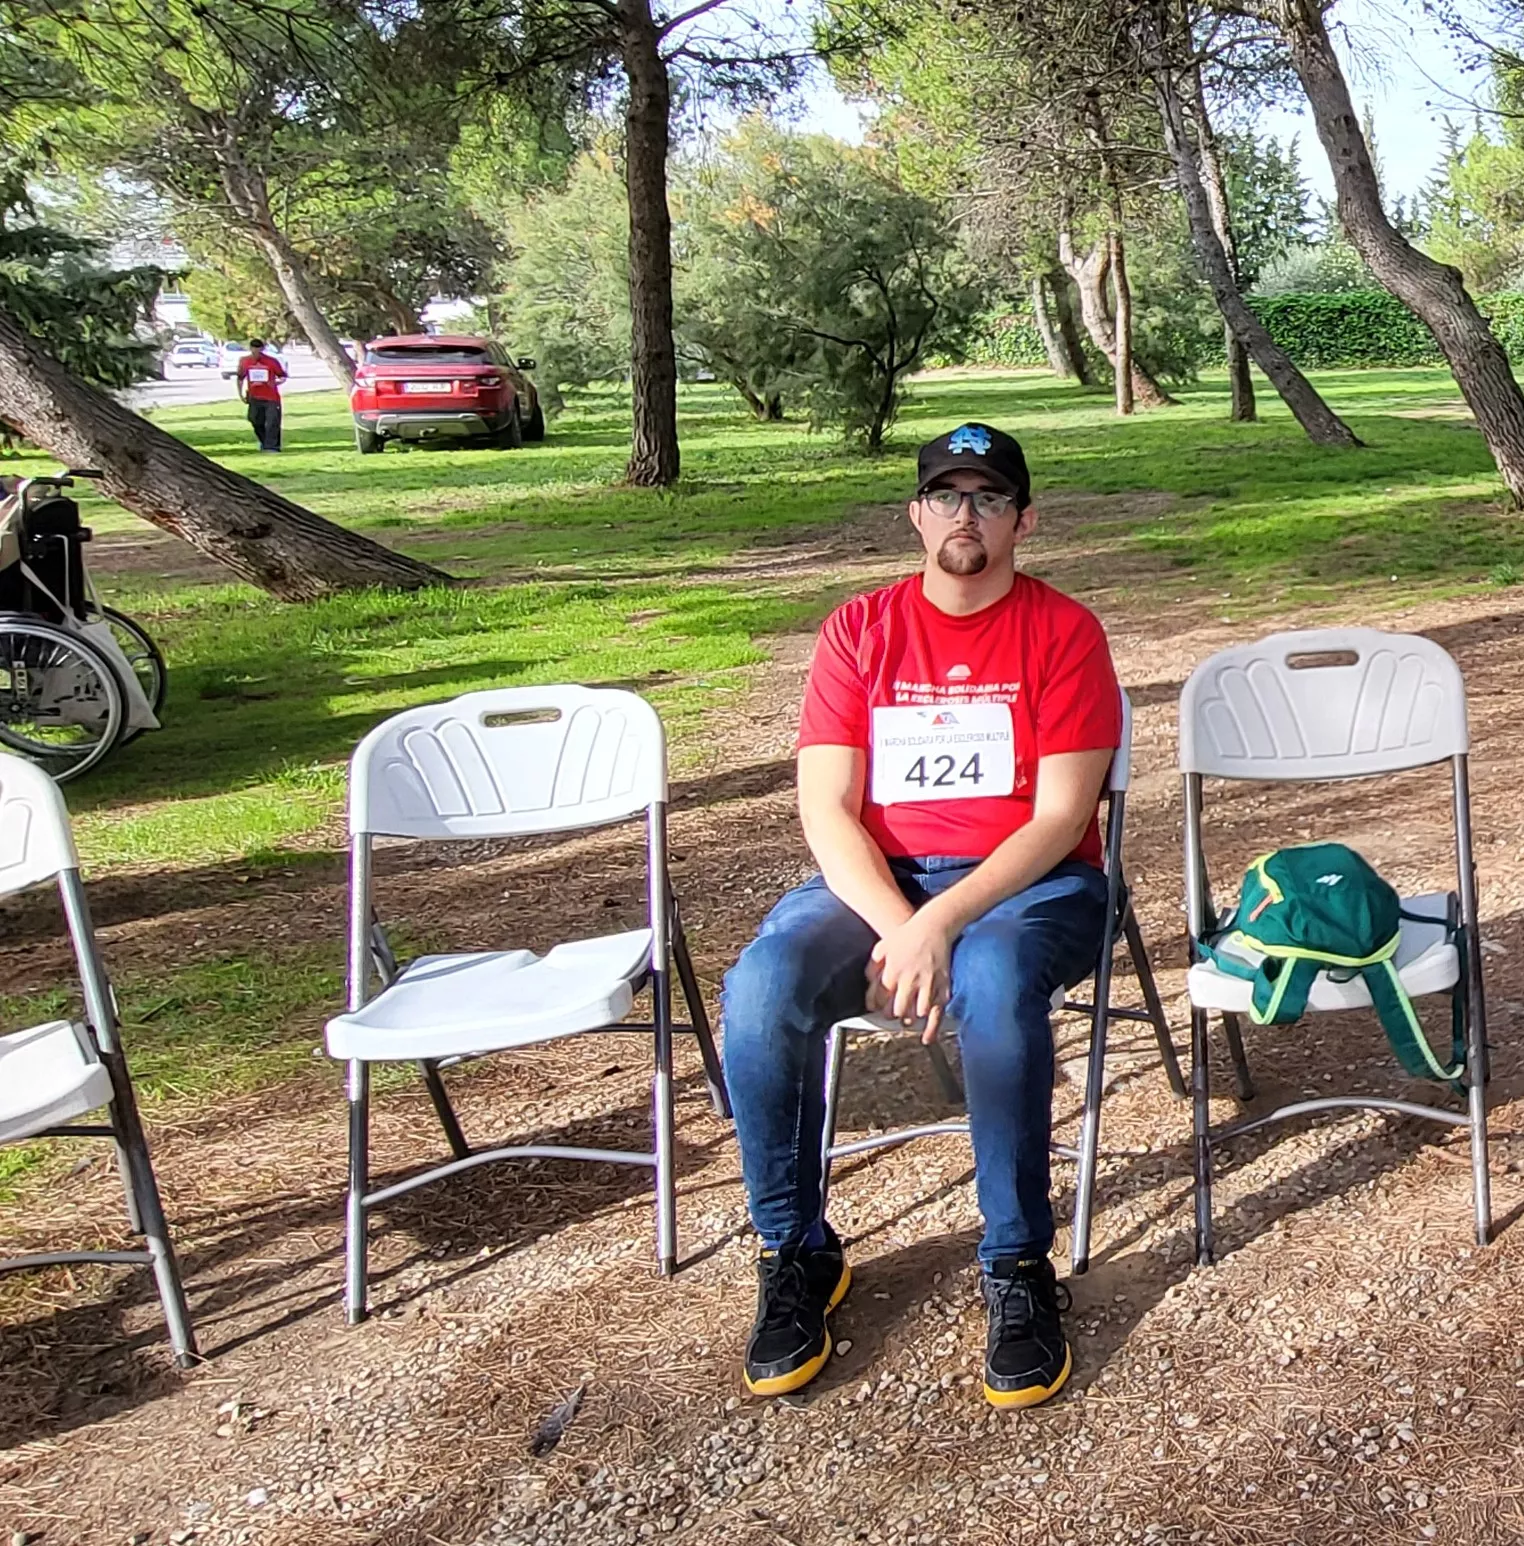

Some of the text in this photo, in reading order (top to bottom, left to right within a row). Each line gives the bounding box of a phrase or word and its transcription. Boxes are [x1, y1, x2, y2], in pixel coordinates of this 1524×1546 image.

[895, 690, 909, 702] LA
[900, 680, 947, 696] MARCHA
[905, 752, 984, 788] 424
